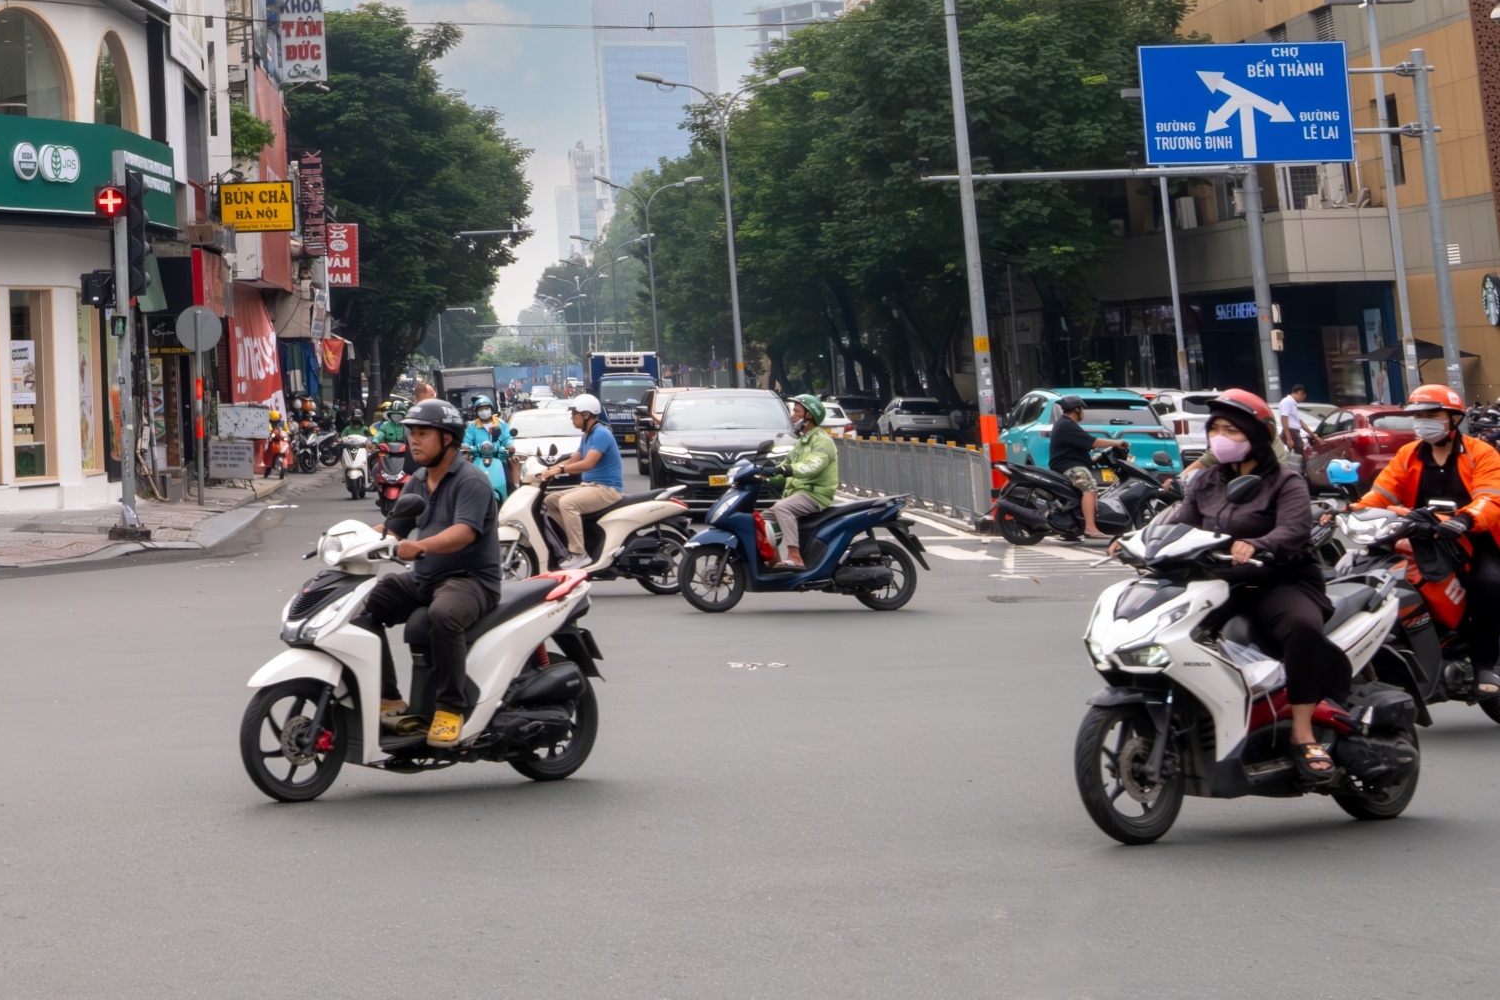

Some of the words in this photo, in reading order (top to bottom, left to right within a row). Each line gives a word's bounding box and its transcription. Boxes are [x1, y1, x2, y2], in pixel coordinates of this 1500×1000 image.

[282, 16, 322, 38] TÂM
[285, 40, 321, 61] ĐỨC
[1271, 46, 1299, 59] CHỢ
[1247, 59, 1275, 78] BẾN
[1278, 60, 1324, 77] THÀNH
[1299, 109, 1340, 122] ĐƯỜNG
[1156, 120, 1196, 132] ĐƯỜNG
[1303, 124, 1318, 140] LÊ
[1321, 126, 1339, 140] LAI
[1154, 136, 1202, 150] TRƯƠNG
[1204, 135, 1233, 152] ĐỊNH
[62, 157, 77, 170] JAS
[224, 187, 254, 206] BÚN
[258, 184, 289, 204] CHẢ
[235, 208, 252, 219] HÀ
[256, 207, 278, 220] NỘI
[1215, 301, 1258, 320] SKECHERS
